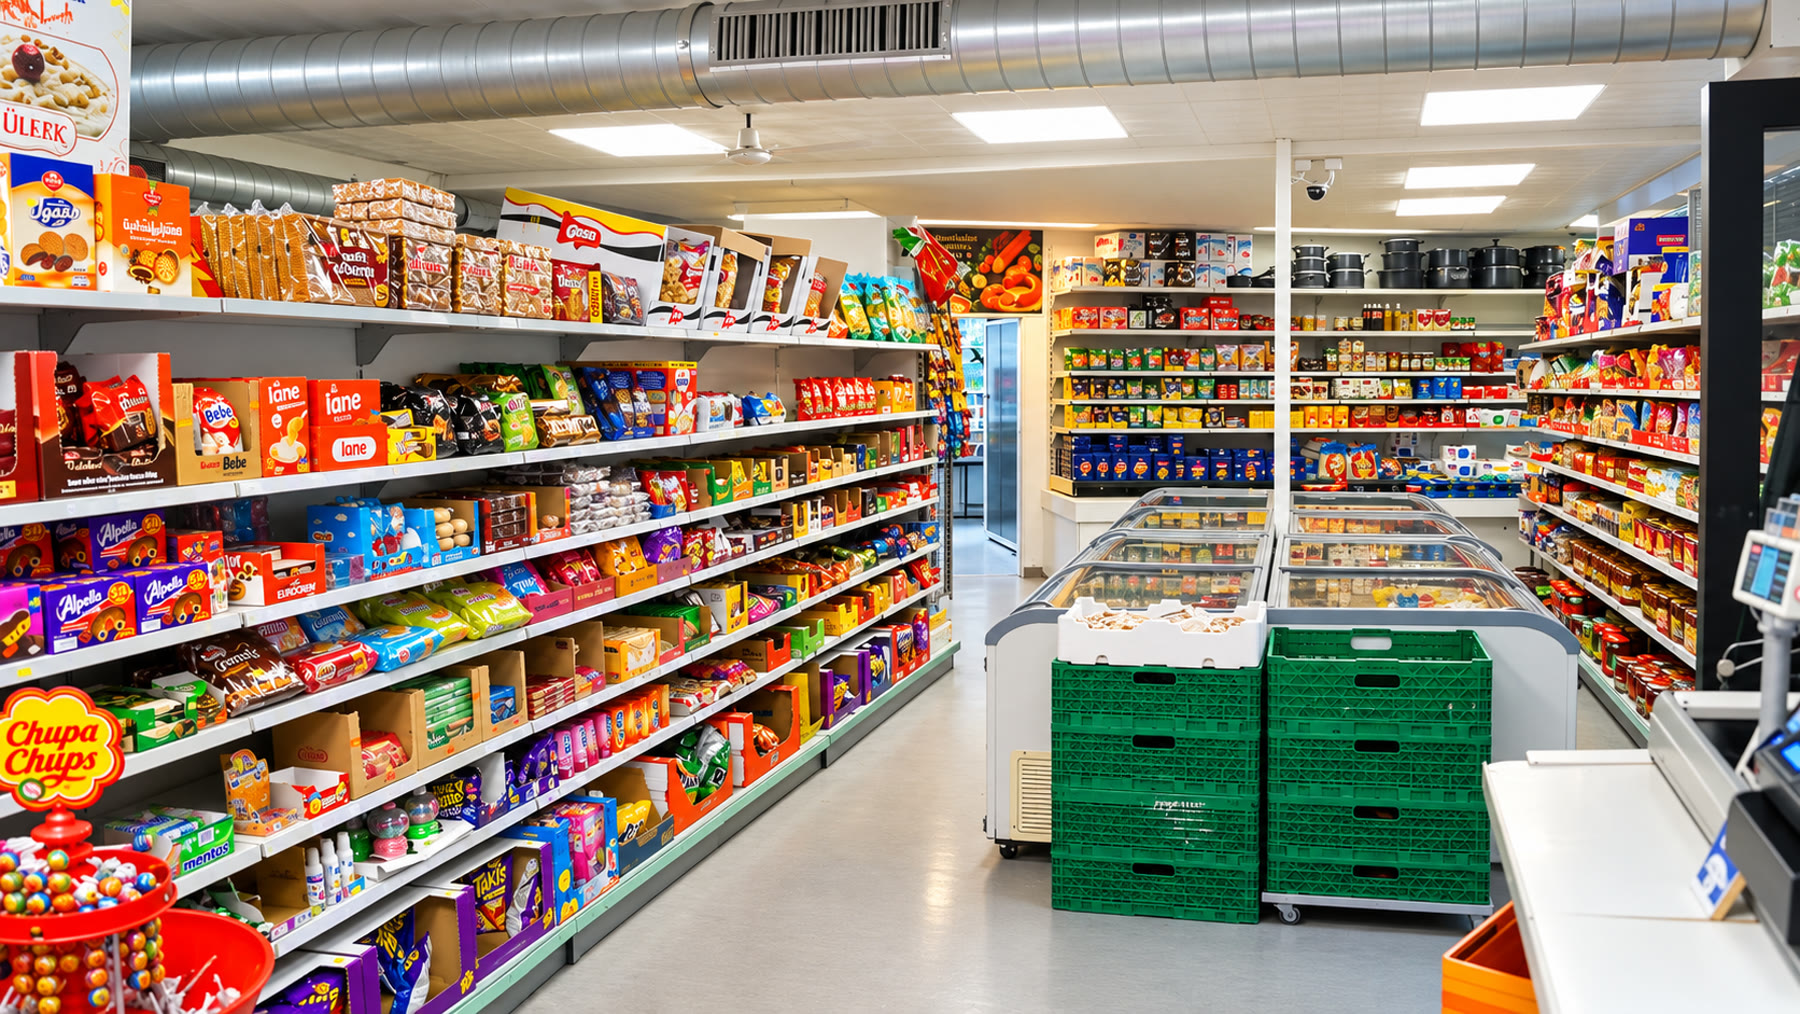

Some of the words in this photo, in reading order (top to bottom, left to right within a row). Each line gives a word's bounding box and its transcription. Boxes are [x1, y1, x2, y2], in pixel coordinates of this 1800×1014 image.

[205, 403, 233, 423] Bebe
[223, 456, 247, 471] Bebe
[6, 720, 100, 751] Chupa
[4, 748, 98, 784] Chups
[183, 841, 230, 871] mentos
